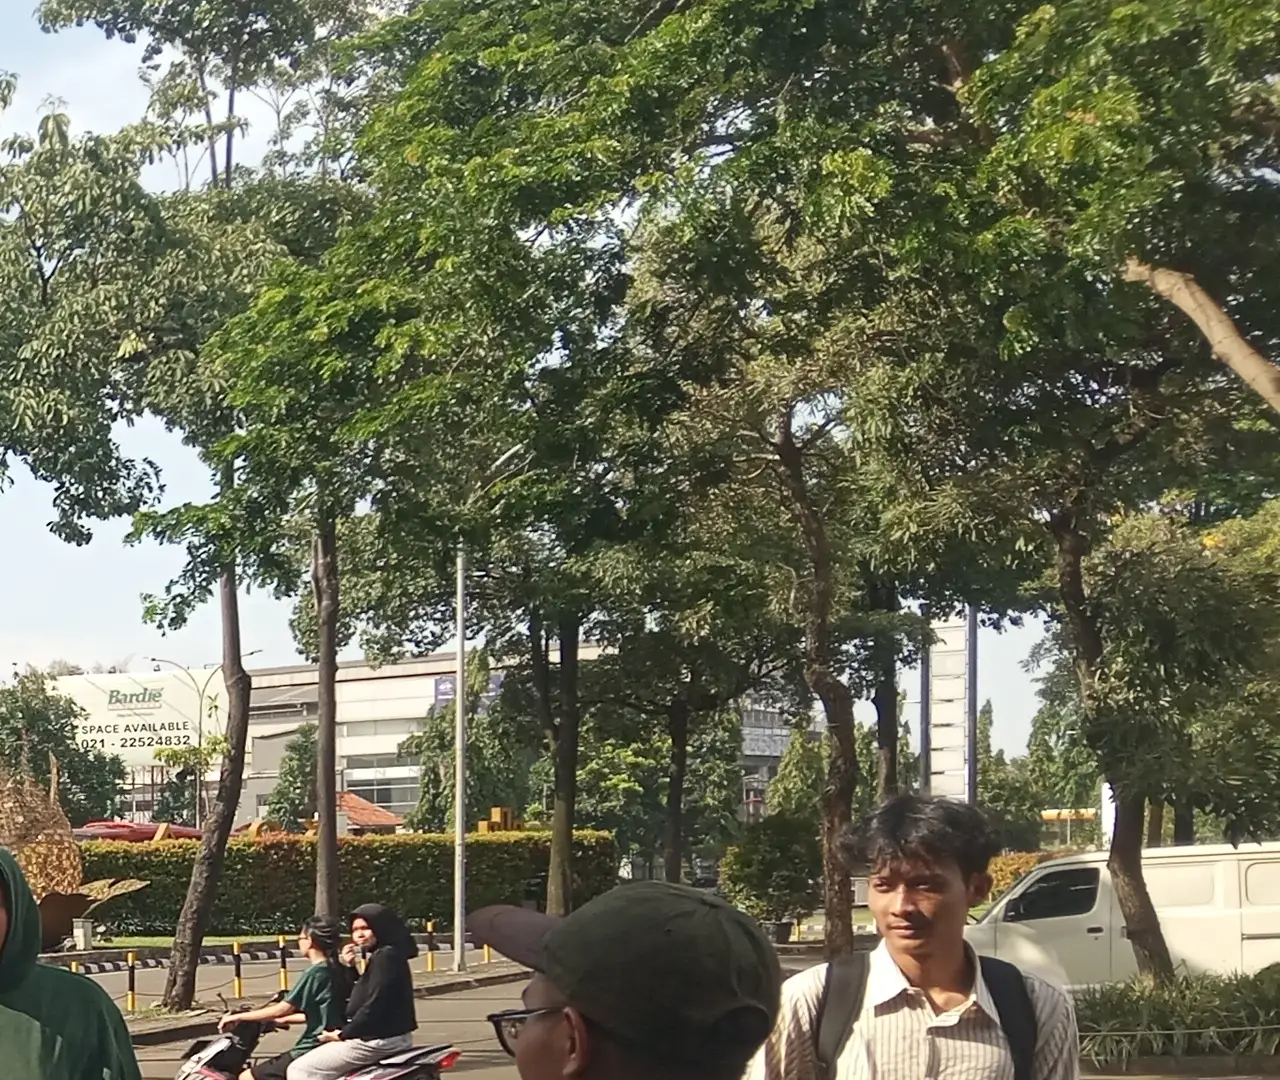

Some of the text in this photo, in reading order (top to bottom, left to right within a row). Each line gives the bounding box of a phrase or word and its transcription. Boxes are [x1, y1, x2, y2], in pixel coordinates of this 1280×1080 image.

[82, 721, 190, 734] SPACE AVAILABLE
[81, 739, 105, 749] 021
[120, 735, 191, 748] 22524832
